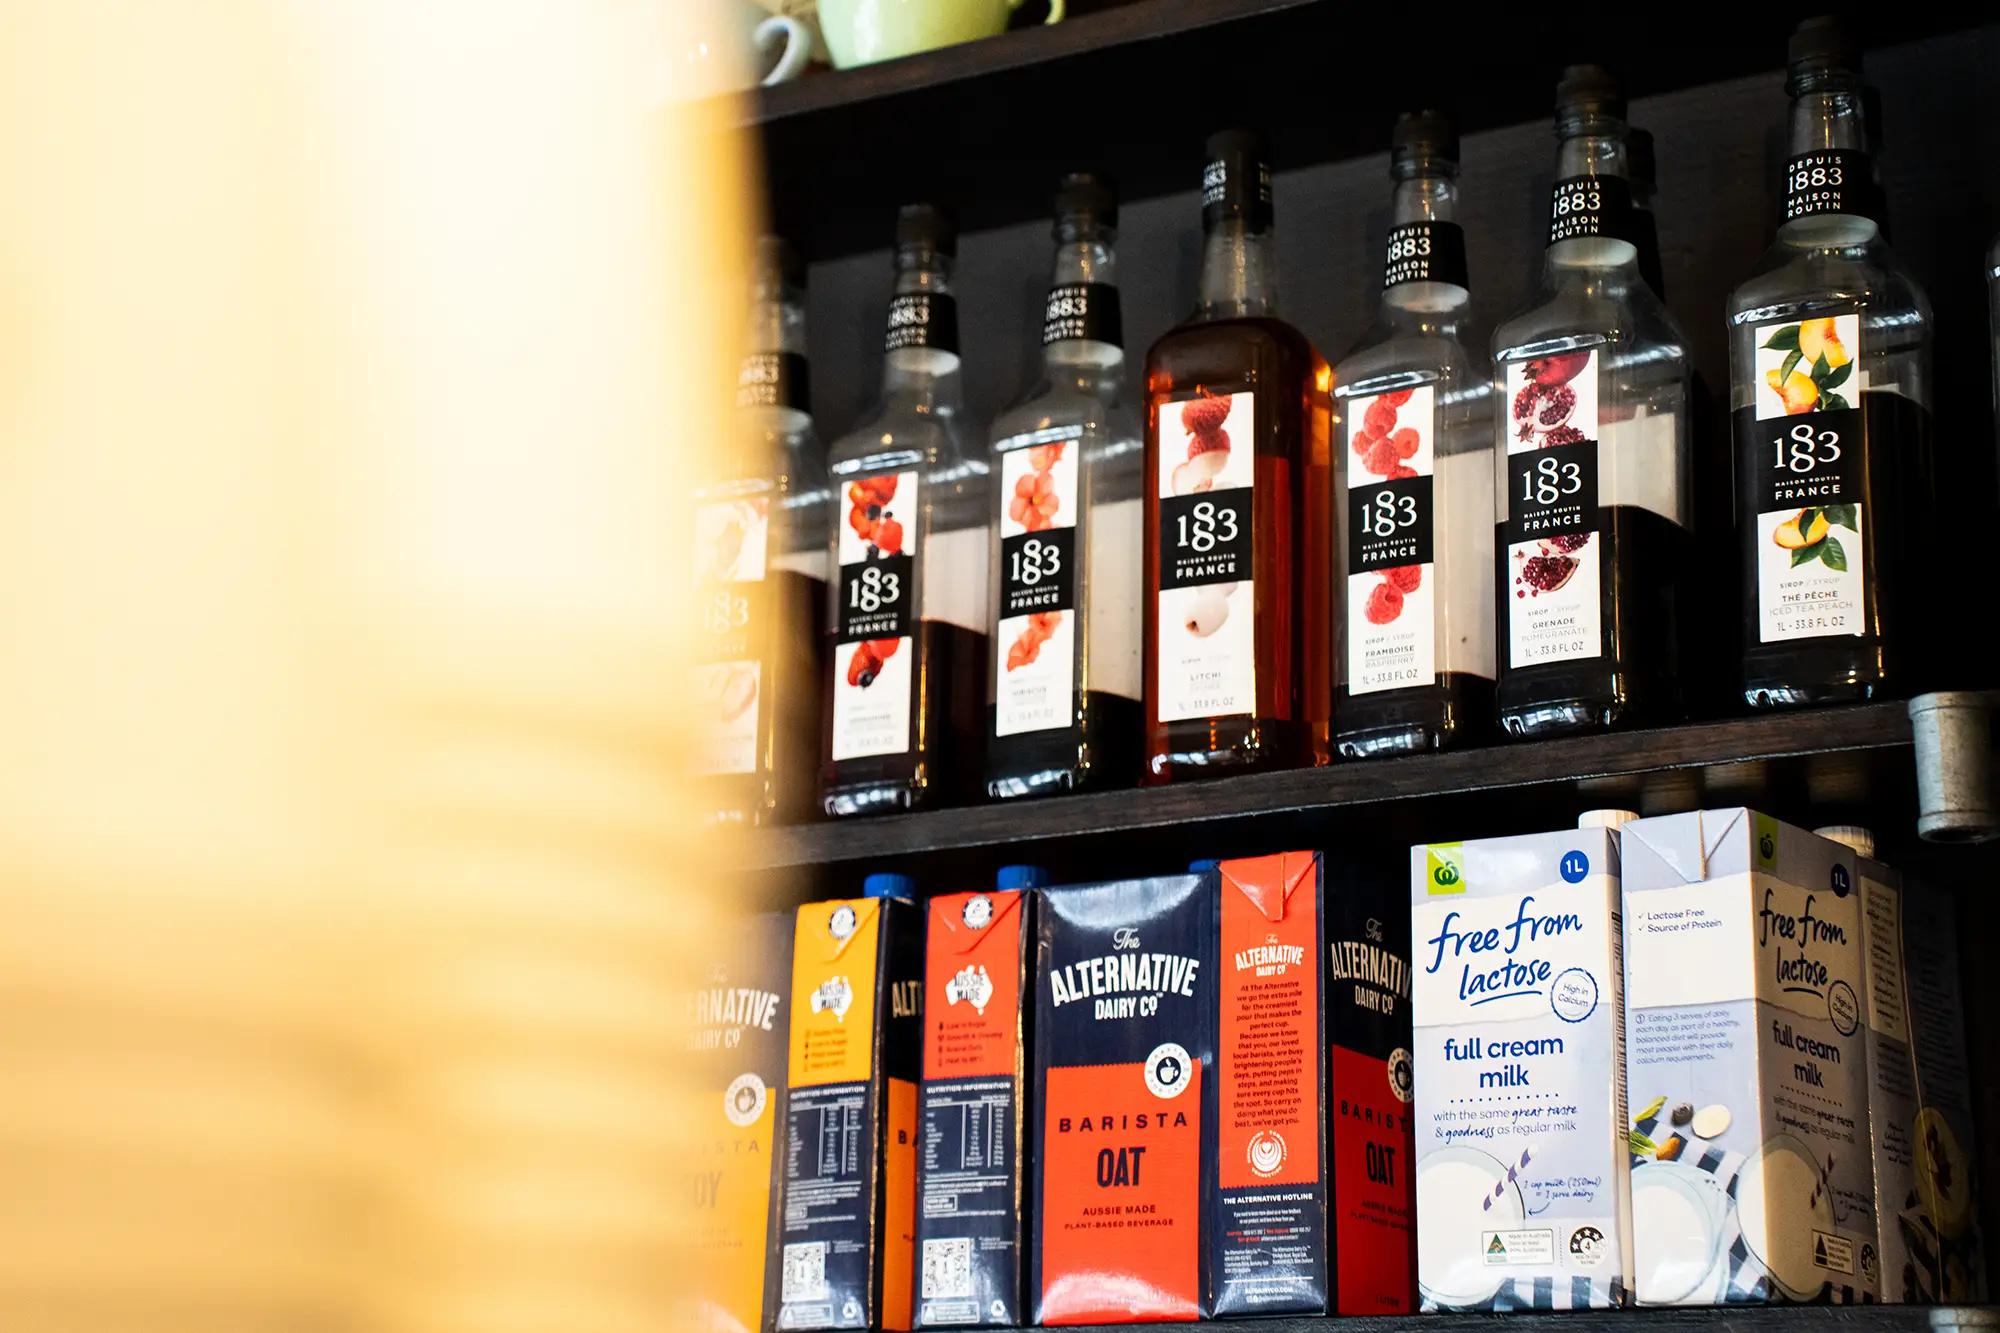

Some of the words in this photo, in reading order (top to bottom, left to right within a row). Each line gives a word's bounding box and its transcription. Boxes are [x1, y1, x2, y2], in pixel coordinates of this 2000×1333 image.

[1789, 156, 1842, 173] DEPUIS
[1554, 181, 1600, 198] DEPUIS
[1788, 167, 1843, 194] 1883
[1553, 192, 1601, 218] 1883
[1788, 192, 1841, 208] MAISON
[1788, 202, 1841, 218] ROUTIN
[1552, 216, 1599, 232] MAISON
[1551, 226, 1599, 242] ROUTIN
[1387, 237, 1431, 264] 1883
[1773, 424, 1841, 473] 1883
[1522, 457, 1582, 505] 1883
[1775, 478, 1806, 487] MAISON
[1775, 484, 1841, 500] FRANCE
[1362, 490, 1418, 537] 1883
[1176, 502, 1238, 552] 1883
[1524, 514, 1581, 532] FRANCE
[1011, 539, 1061, 585] 1883
[1362, 546, 1417, 563] FRANCE
[1176, 562, 1236, 580] FRANCE
[849, 567, 900, 612] 1883
[1780, 580, 1804, 589] SIROP
[1011, 593, 1060, 610] FRANCE
[1804, 590, 1839, 600] PÊCHE
[1769, 606, 1792, 617] ICED
[1795, 603, 1815, 613] TEA
[1818, 600, 1853, 611] PEACH
[1532, 617, 1576, 630] GRENADE
[1795, 618, 1814, 630] 33.8
[1816, 617, 1828, 628] FL
[1831, 615, 1845, 627] OZ
[1365, 645, 1415, 658] FRAMBOISE
[1559, 642, 1569, 652] FL
[1571, 641, 1584, 651] OZ
[1394, 669, 1404, 681] FL
[1406, 668, 1418, 679] OZ
[1566, 859, 1583, 874] 1L
[1834, 872, 1846, 888] 1L
[1647, 912, 1684, 921] Lactose
[1686, 909, 1705, 918] Free
[1759, 887, 1796, 948] free
[1797, 894, 1847, 948] from
[1426, 912, 1500, 973] free
[1504, 896, 1583, 954] from
[1647, 924, 1679, 933] Source
[1681, 922, 1691, 931] of
[1692, 919, 1722, 931] Protein
[1113, 927, 1140, 950] The
[1235, 945, 1304, 971] ALTERNATIVE
[1777, 946, 1828, 986] lactose
[1050, 953, 1200, 1007] ALTERNATIVE
[1256, 966, 1277, 977] DAIRY
[1331, 941, 1412, 1002] ALTERNATIV
[1459, 959, 1552, 1000] lactose
[1264, 981, 1299, 990] Alternative
[1562, 983, 1579, 995] High
[1580, 988, 1589, 996] in
[1271, 992, 1288, 1000] extra
[1355, 984, 1380, 1012] DAIRY
[1558, 993, 1589, 1008] Calcium
[1095, 997, 1137, 1020] DAIRY
[1444, 1037, 1482, 1061] full
[1487, 1037, 1564, 1059] cream
[1773, 1019, 1794, 1051] full
[1795, 1034, 1840, 1065] cream
[1479, 1064, 1530, 1088] milk
[1794, 1061, 1825, 1090] milk
[1059, 1112, 1188, 1133] BARISTA
[1341, 1100, 1415, 1134] BARIST
[1433, 1110, 1457, 1122] with
[1459, 1109, 1477, 1120] the
[1480, 1110, 1510, 1120] same
[1511, 1106, 1542, 1124] great
[1547, 1104, 1578, 1116] taste
[1435, 1127, 1444, 1138] &
[1445, 1125, 1495, 1144] goodness
[1497, 1126, 1510, 1135] as
[1512, 1122, 1551, 1137] regular
[1553, 1120, 1577, 1132] milk
[1097, 1147, 1146, 1187] OAT
[1366, 1141, 1395, 1187] OAT
[1224, 1197, 1236, 1205] THE
[1237, 1194, 1282, 1204] ALTERNATIVE
[1283, 1193, 1313, 1201] HOTLINE
[1082, 1206, 1121, 1216] AUSSIE
[1125, 1204, 1156, 1215] MADE
[1064, 1220, 1124, 1230] PLANT-BASED
[1127, 1219, 1174, 1228] BEVERAGE
